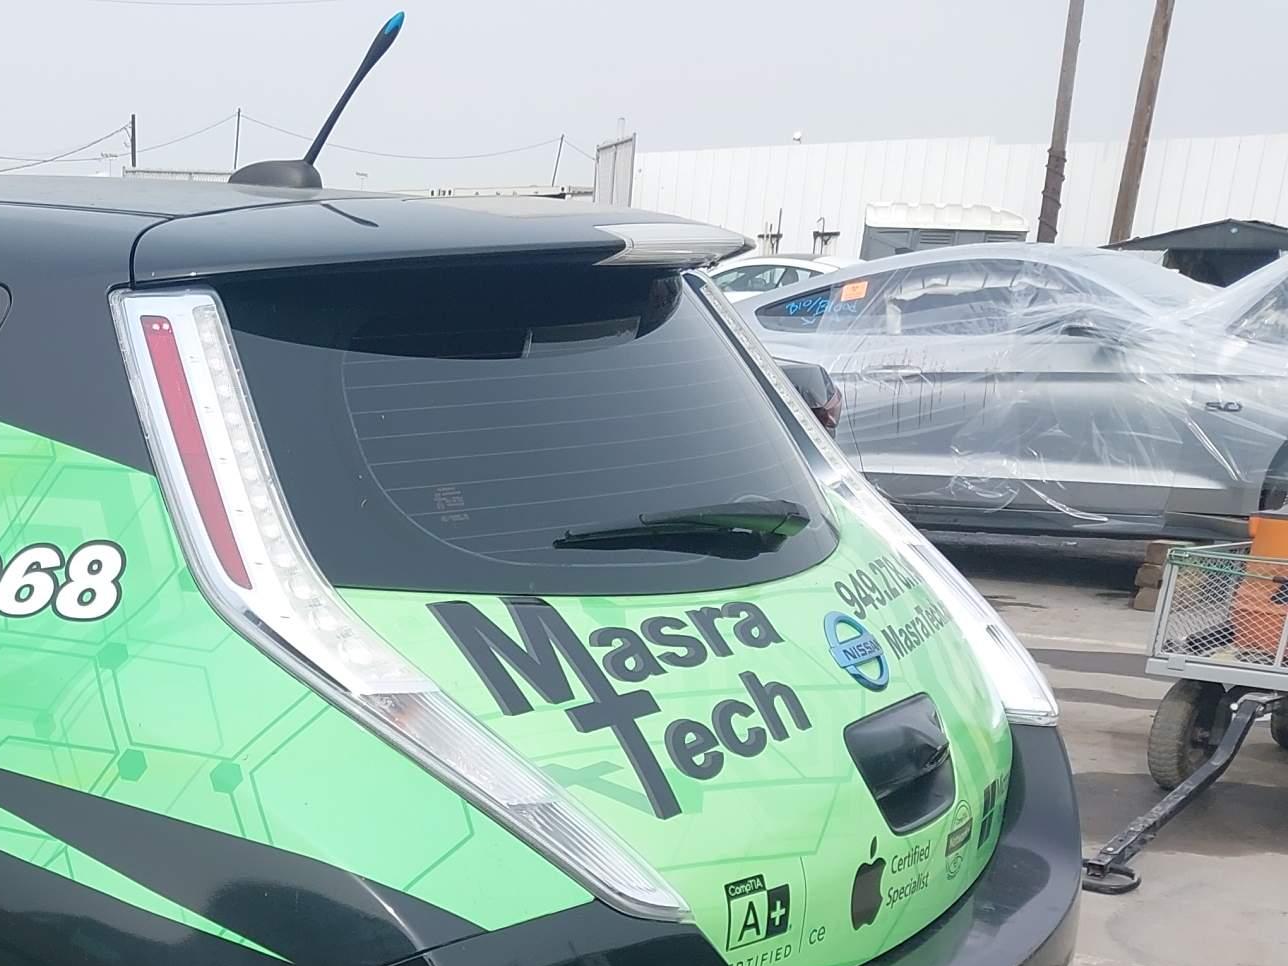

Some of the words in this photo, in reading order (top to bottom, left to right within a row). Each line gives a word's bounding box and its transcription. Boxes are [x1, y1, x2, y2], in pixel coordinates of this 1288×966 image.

[425, 597, 785, 717] Masra
[565, 671, 812, 820] Tech
[891, 840, 931, 875] Certified
[728, 876, 764, 897] CompTIA
[886, 872, 930, 909] Specialist
